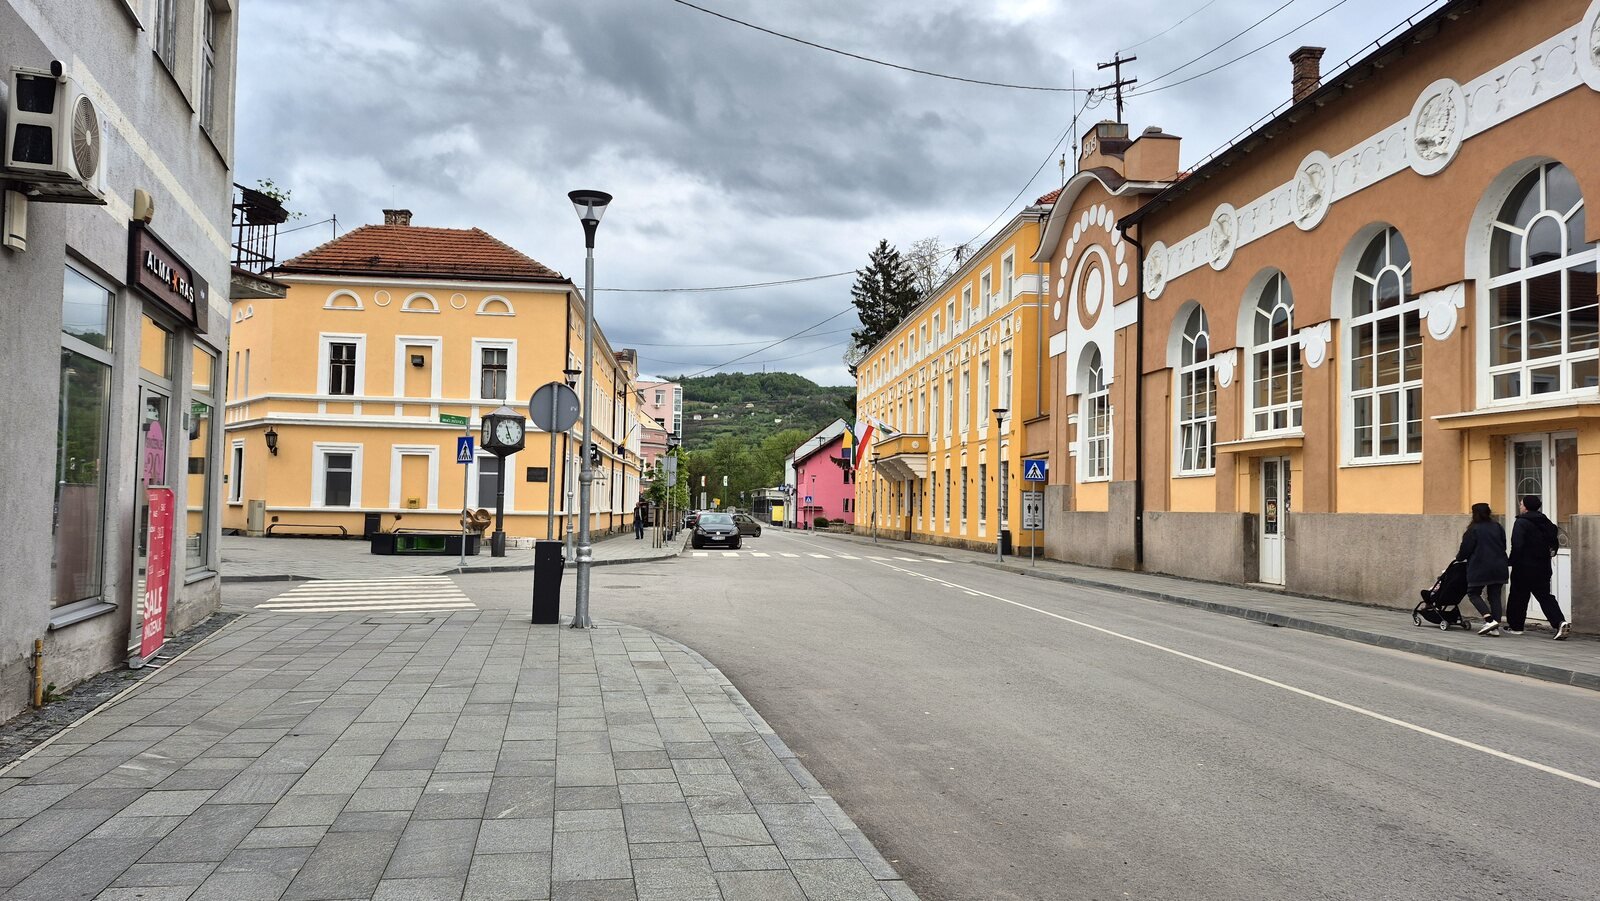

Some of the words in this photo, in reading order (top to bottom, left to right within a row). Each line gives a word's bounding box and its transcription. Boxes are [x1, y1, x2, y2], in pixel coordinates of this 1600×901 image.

[147, 250, 171, 285] ALMA
[179, 277, 194, 303] RAS
[144, 586, 163, 620] SALE
